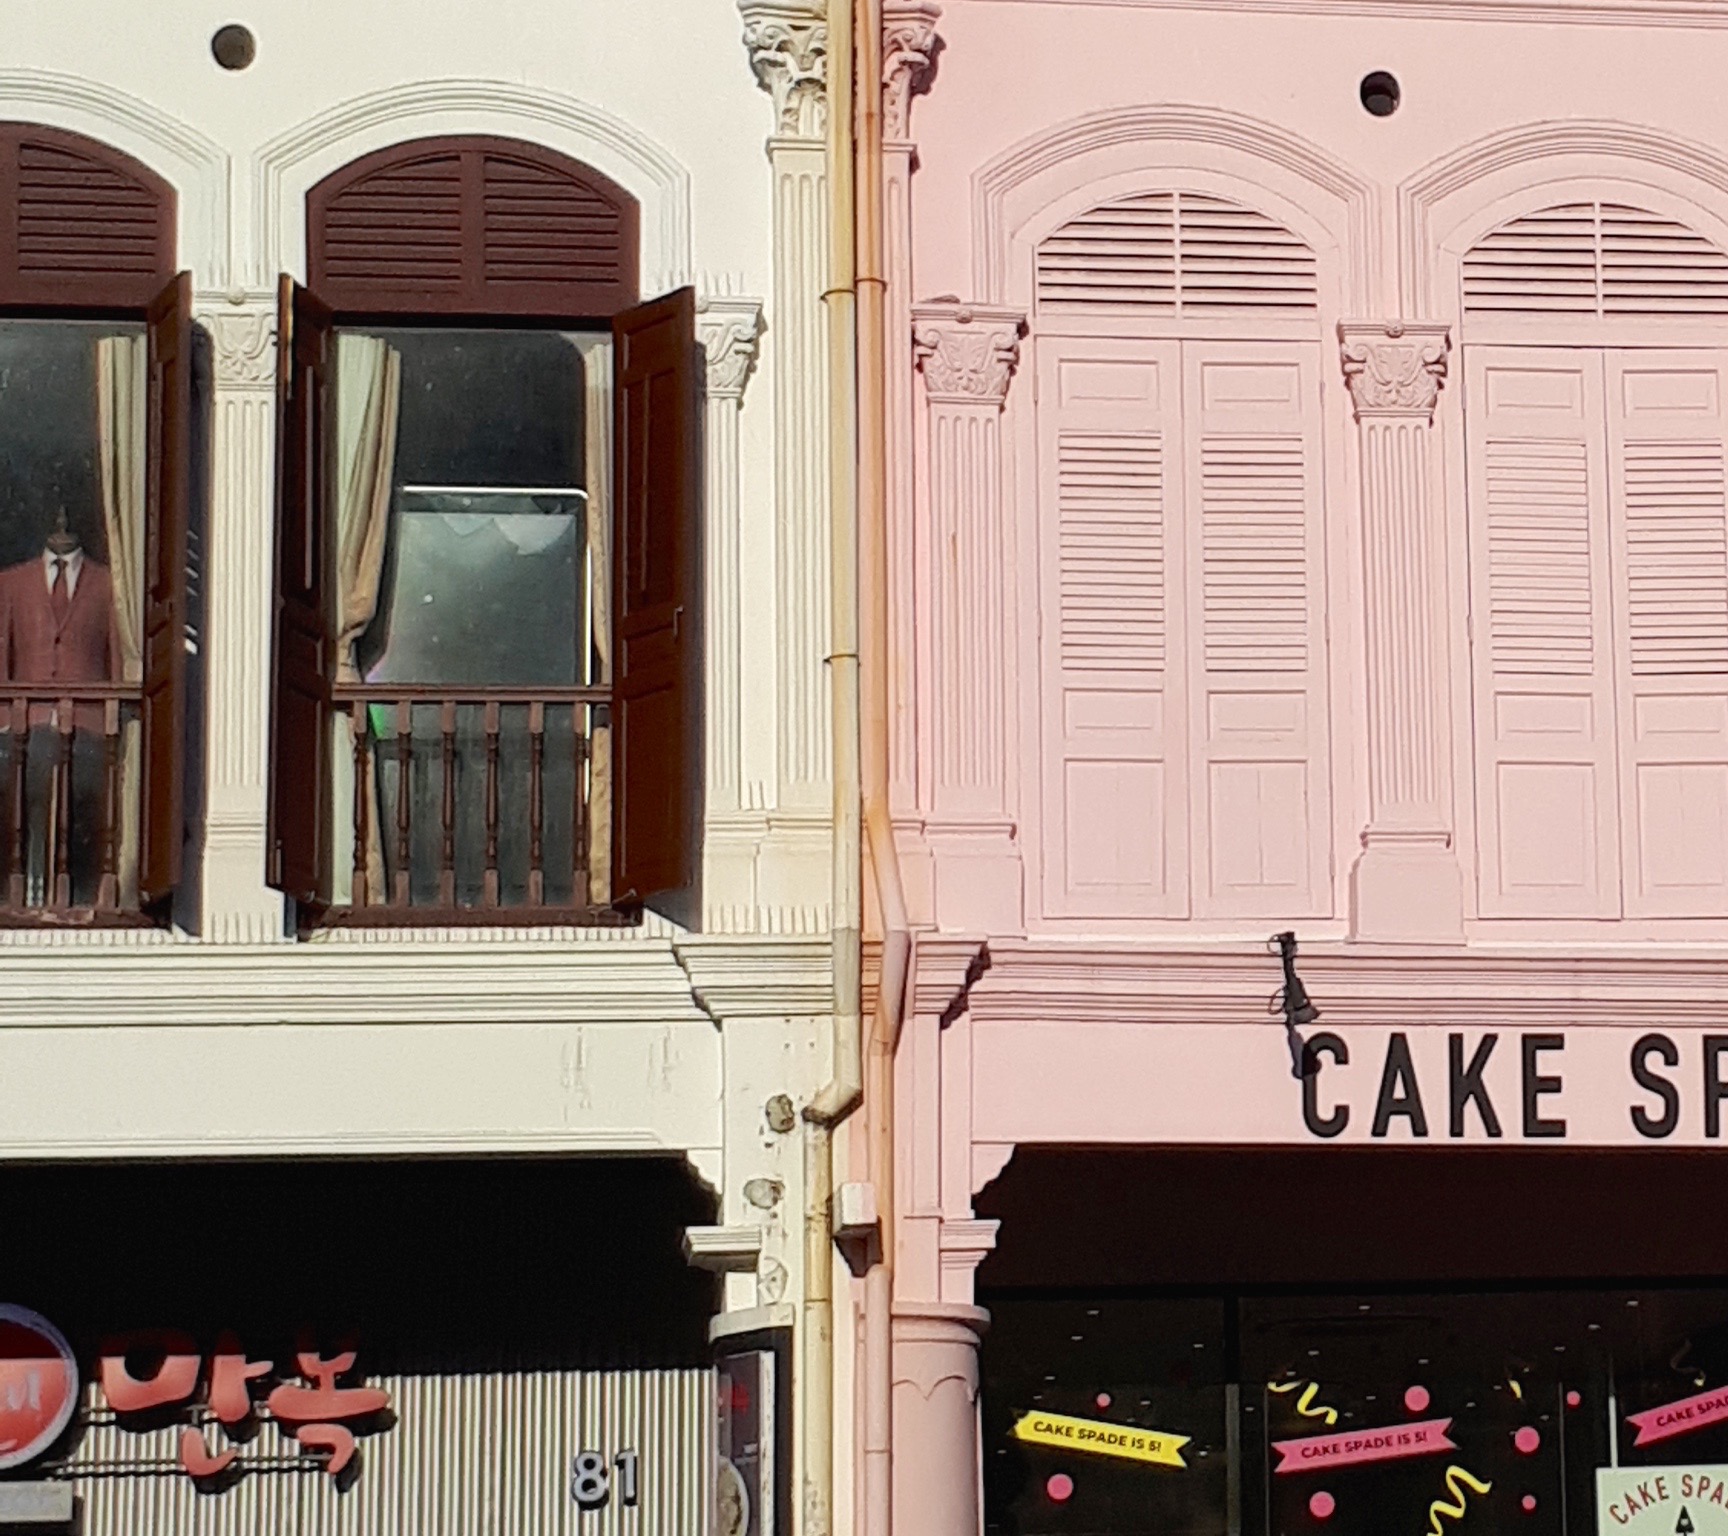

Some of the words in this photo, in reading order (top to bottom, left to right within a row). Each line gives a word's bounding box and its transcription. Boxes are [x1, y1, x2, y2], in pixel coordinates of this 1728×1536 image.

[1300, 1032, 1568, 1139] CAKE
[1033, 1420, 1074, 1441] CAKE
[1077, 1427, 1130, 1449] SPADE
[1131, 1435, 1146, 1451] IS
[1656, 1408, 1695, 1427] CAKE
[1301, 1440, 1341, 1460] CAKE
[1344, 1434, 1392, 1456] SPADE
[1396, 1433, 1411, 1448] IS
[573, 1450, 636, 1504] 81
[1608, 1476, 1671, 1525] CAKE
